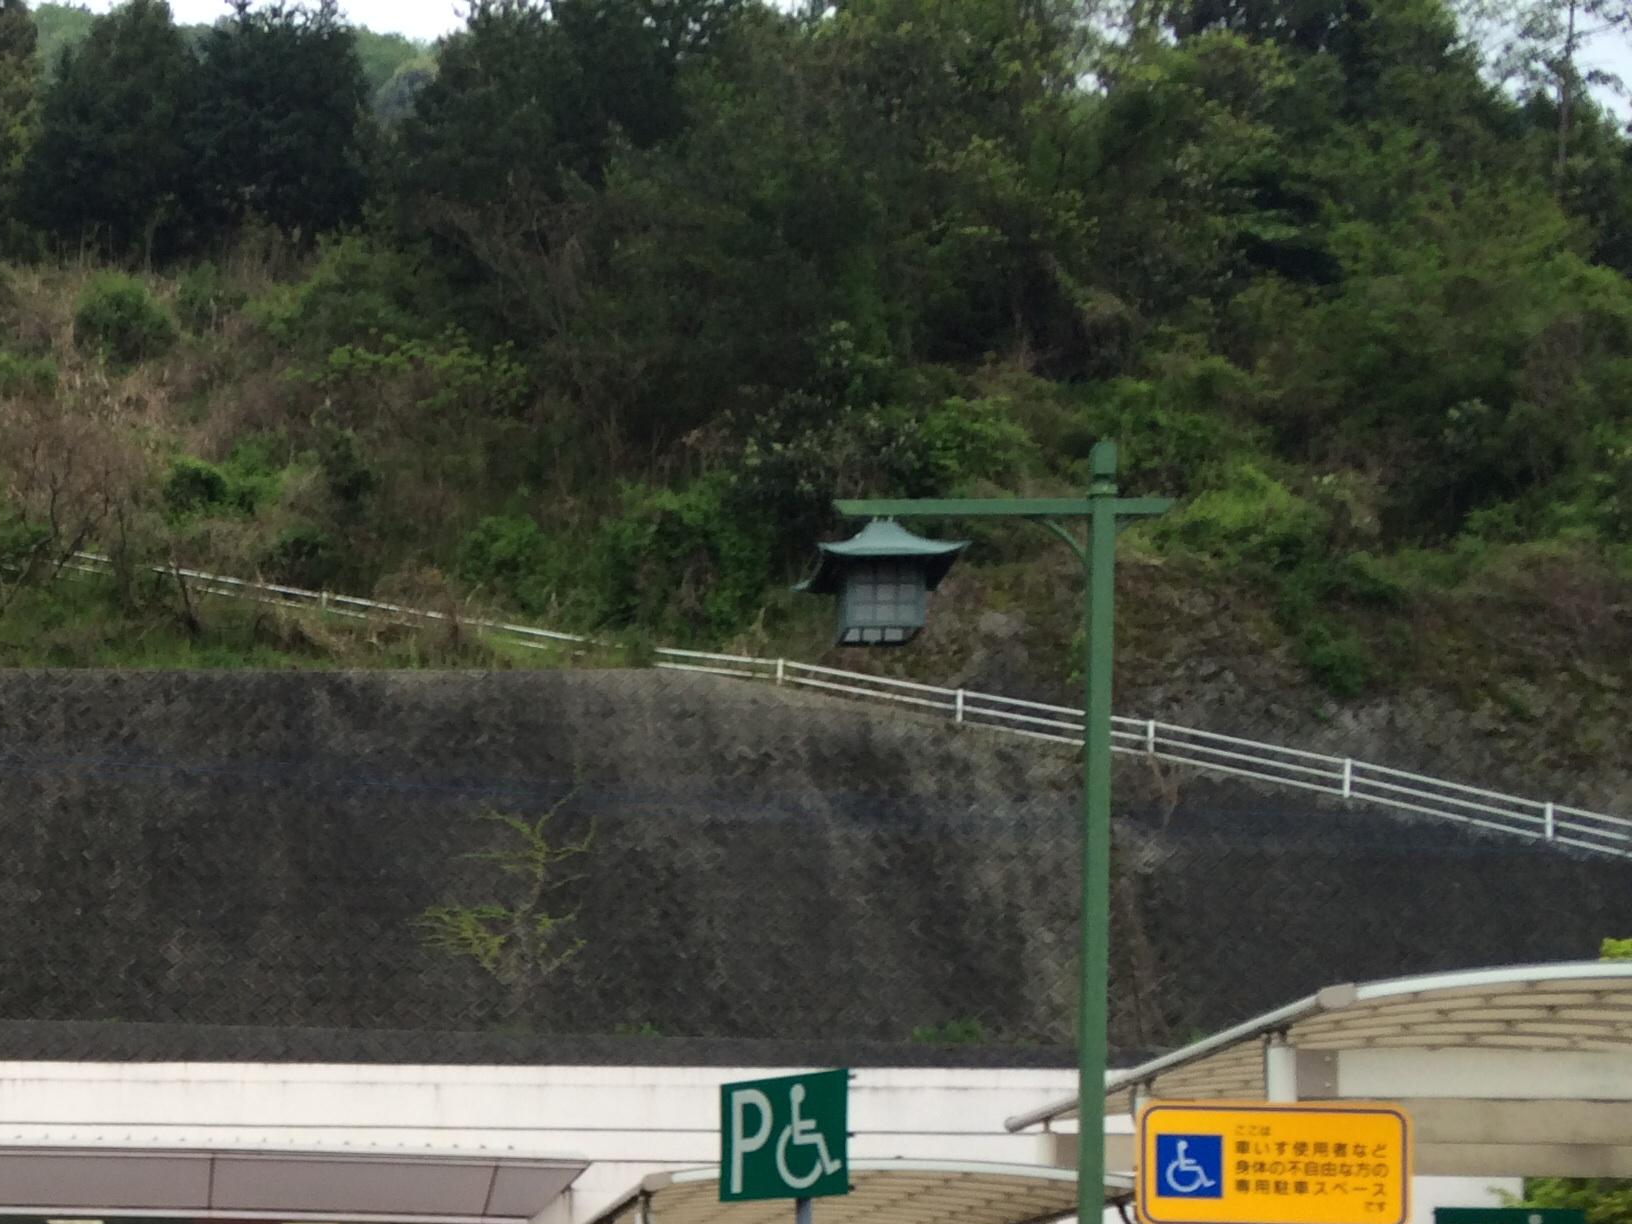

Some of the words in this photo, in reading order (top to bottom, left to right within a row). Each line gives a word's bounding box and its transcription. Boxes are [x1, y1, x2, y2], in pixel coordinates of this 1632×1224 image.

[1235, 1124, 1271, 1137] ここは
[731, 1089, 773, 1194] P
[1235, 1141, 1388, 1159] 車いす使用者など
[1235, 1160, 1389, 1178] 身体の不自由な方の
[1235, 1178, 1387, 1197] 専用駐車スペース
[1364, 1201, 1387, 1213] です
